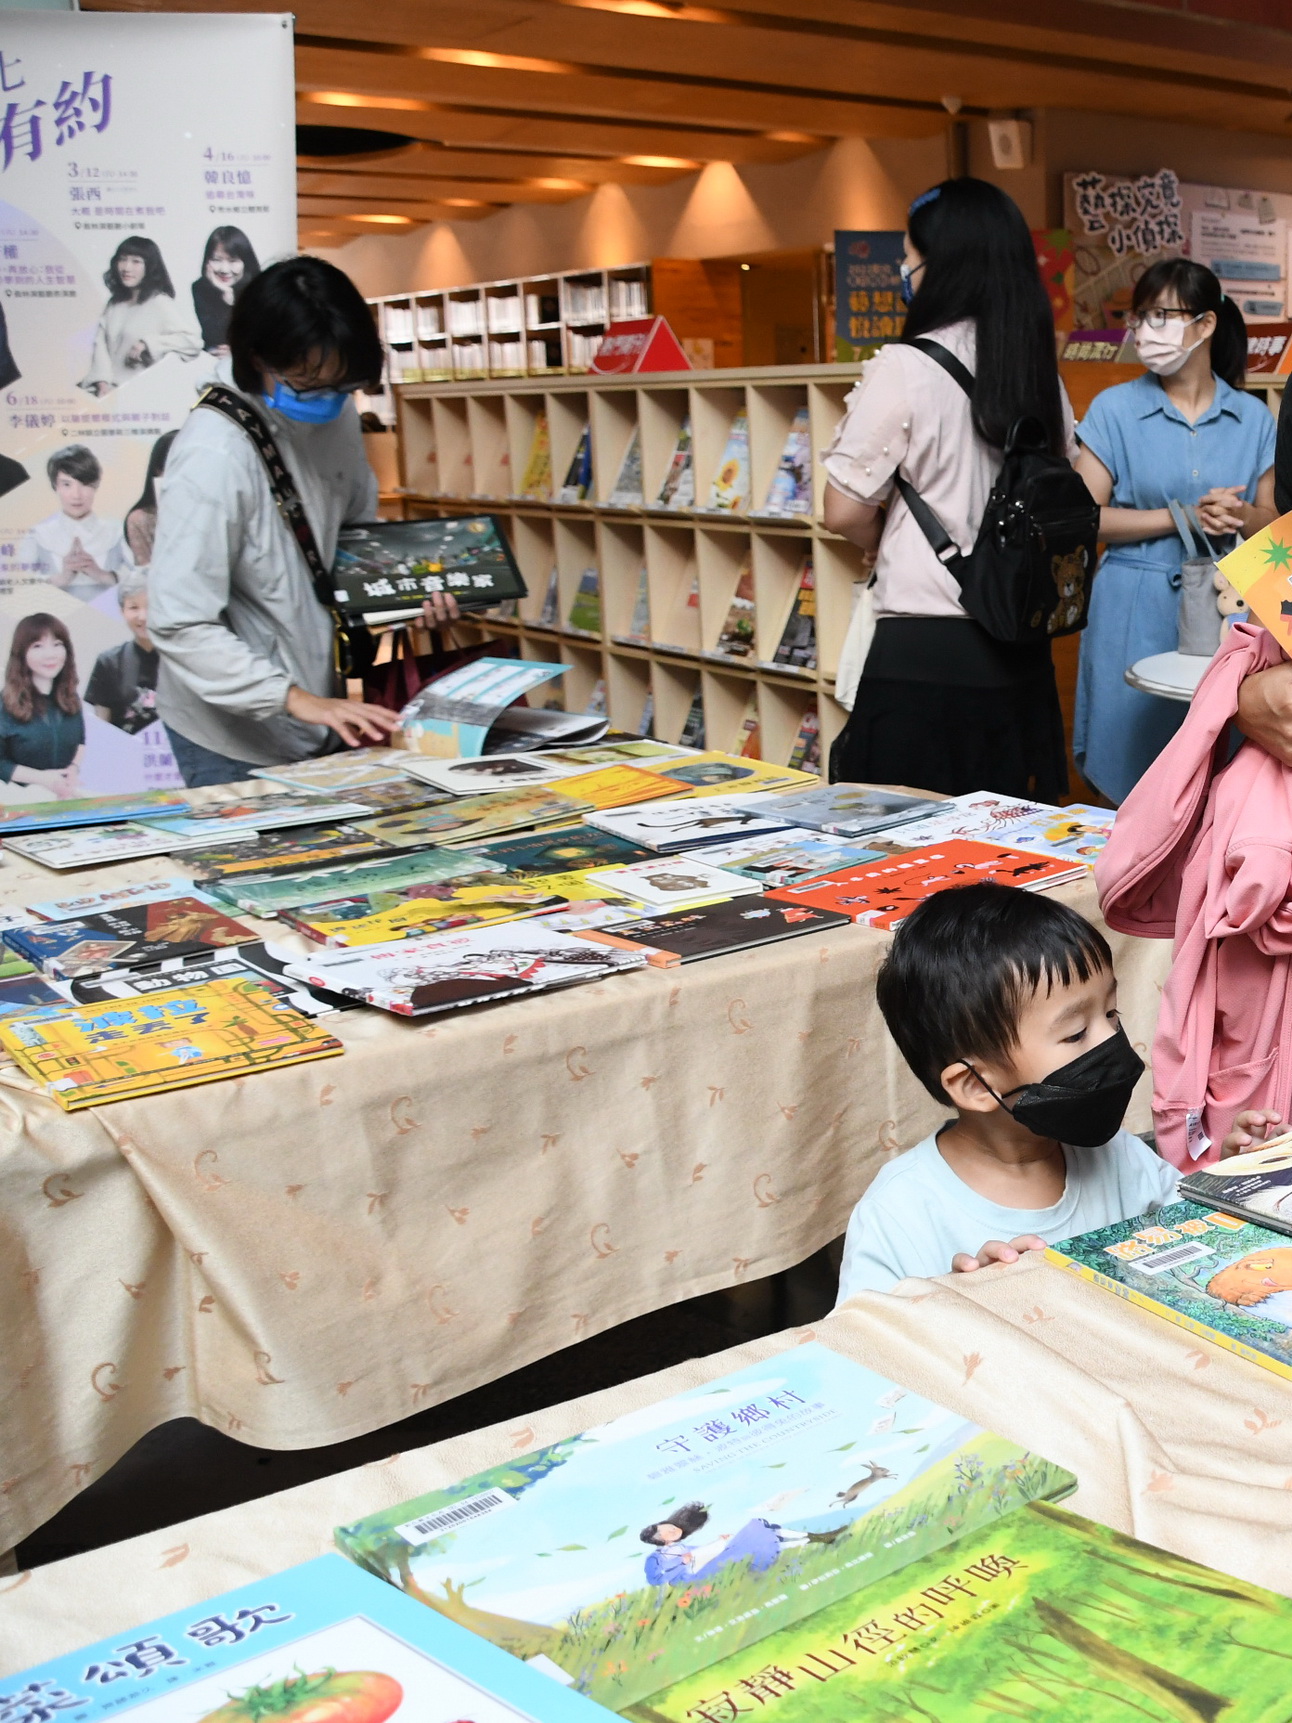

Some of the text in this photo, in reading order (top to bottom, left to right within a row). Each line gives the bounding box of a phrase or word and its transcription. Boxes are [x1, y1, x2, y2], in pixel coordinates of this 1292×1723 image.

[654, 1387, 808, 1459] 守護鄉村
[685, 1550, 1031, 1723] 寂靜山徑的呼喚
